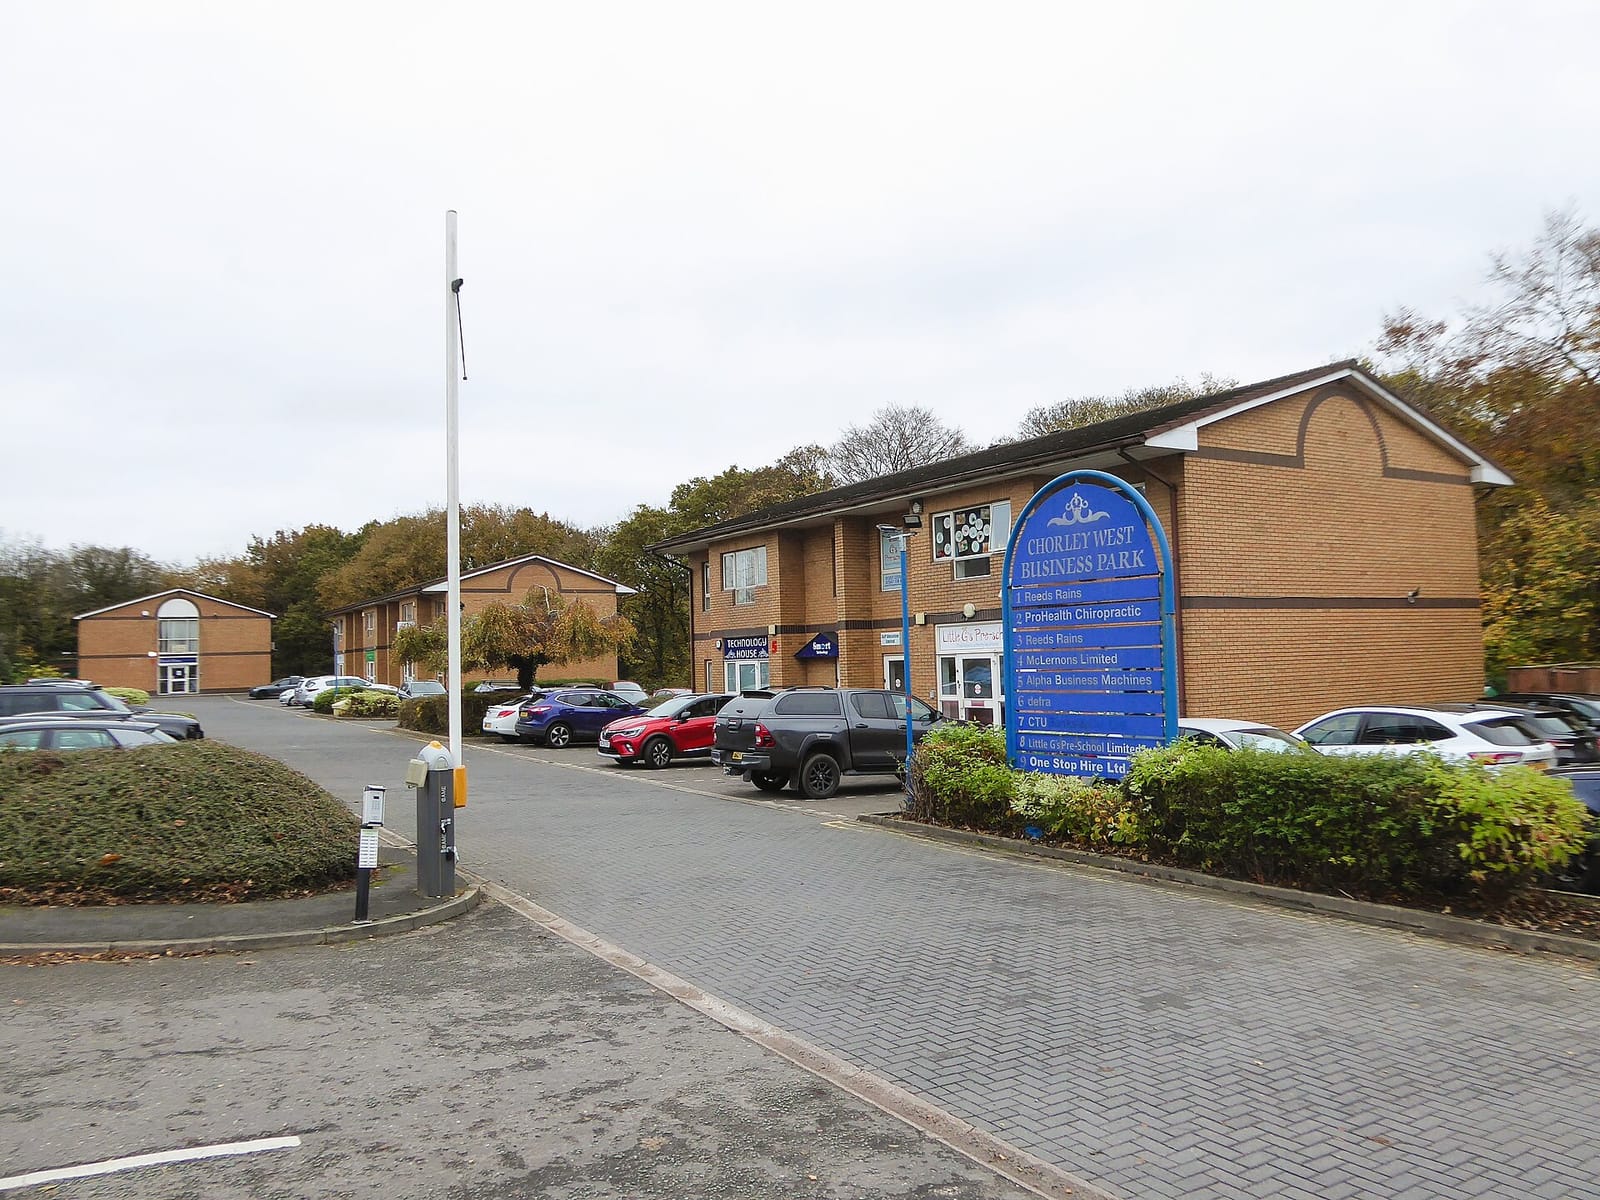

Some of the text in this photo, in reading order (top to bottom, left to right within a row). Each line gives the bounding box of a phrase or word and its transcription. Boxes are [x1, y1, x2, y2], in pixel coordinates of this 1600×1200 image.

[1027, 525, 1135, 556] CHORLEY WEST
[1021, 549, 1145, 579] BUSINESS PARK
[1015, 589, 1082, 603] 1 Reeds Rains
[1016, 605, 1141, 624] 2 ProHealth Chiropractic
[727, 637, 767, 648] TECHNOLOGY
[1016, 633, 1083, 647] 3 Reeds Rains
[736, 649, 757, 658] HOUSE
[1017, 653, 1118, 667] 4 McLernons Limited
[1017, 674, 1152, 688] 5 Alpha Business Machines
[1018, 696, 1051, 707] 6 defra
[1018, 716, 1047, 727] 7 CTU
[1019, 736, 1025, 748] 8
[1028, 737, 1048, 749] Little
[1106, 742, 1141, 753] Limited
[1020, 756, 1026, 767] 9
[1029, 756, 1050, 768] One
[1052, 757, 1077, 771] Stop
[1080, 759, 1103, 771] Hire
